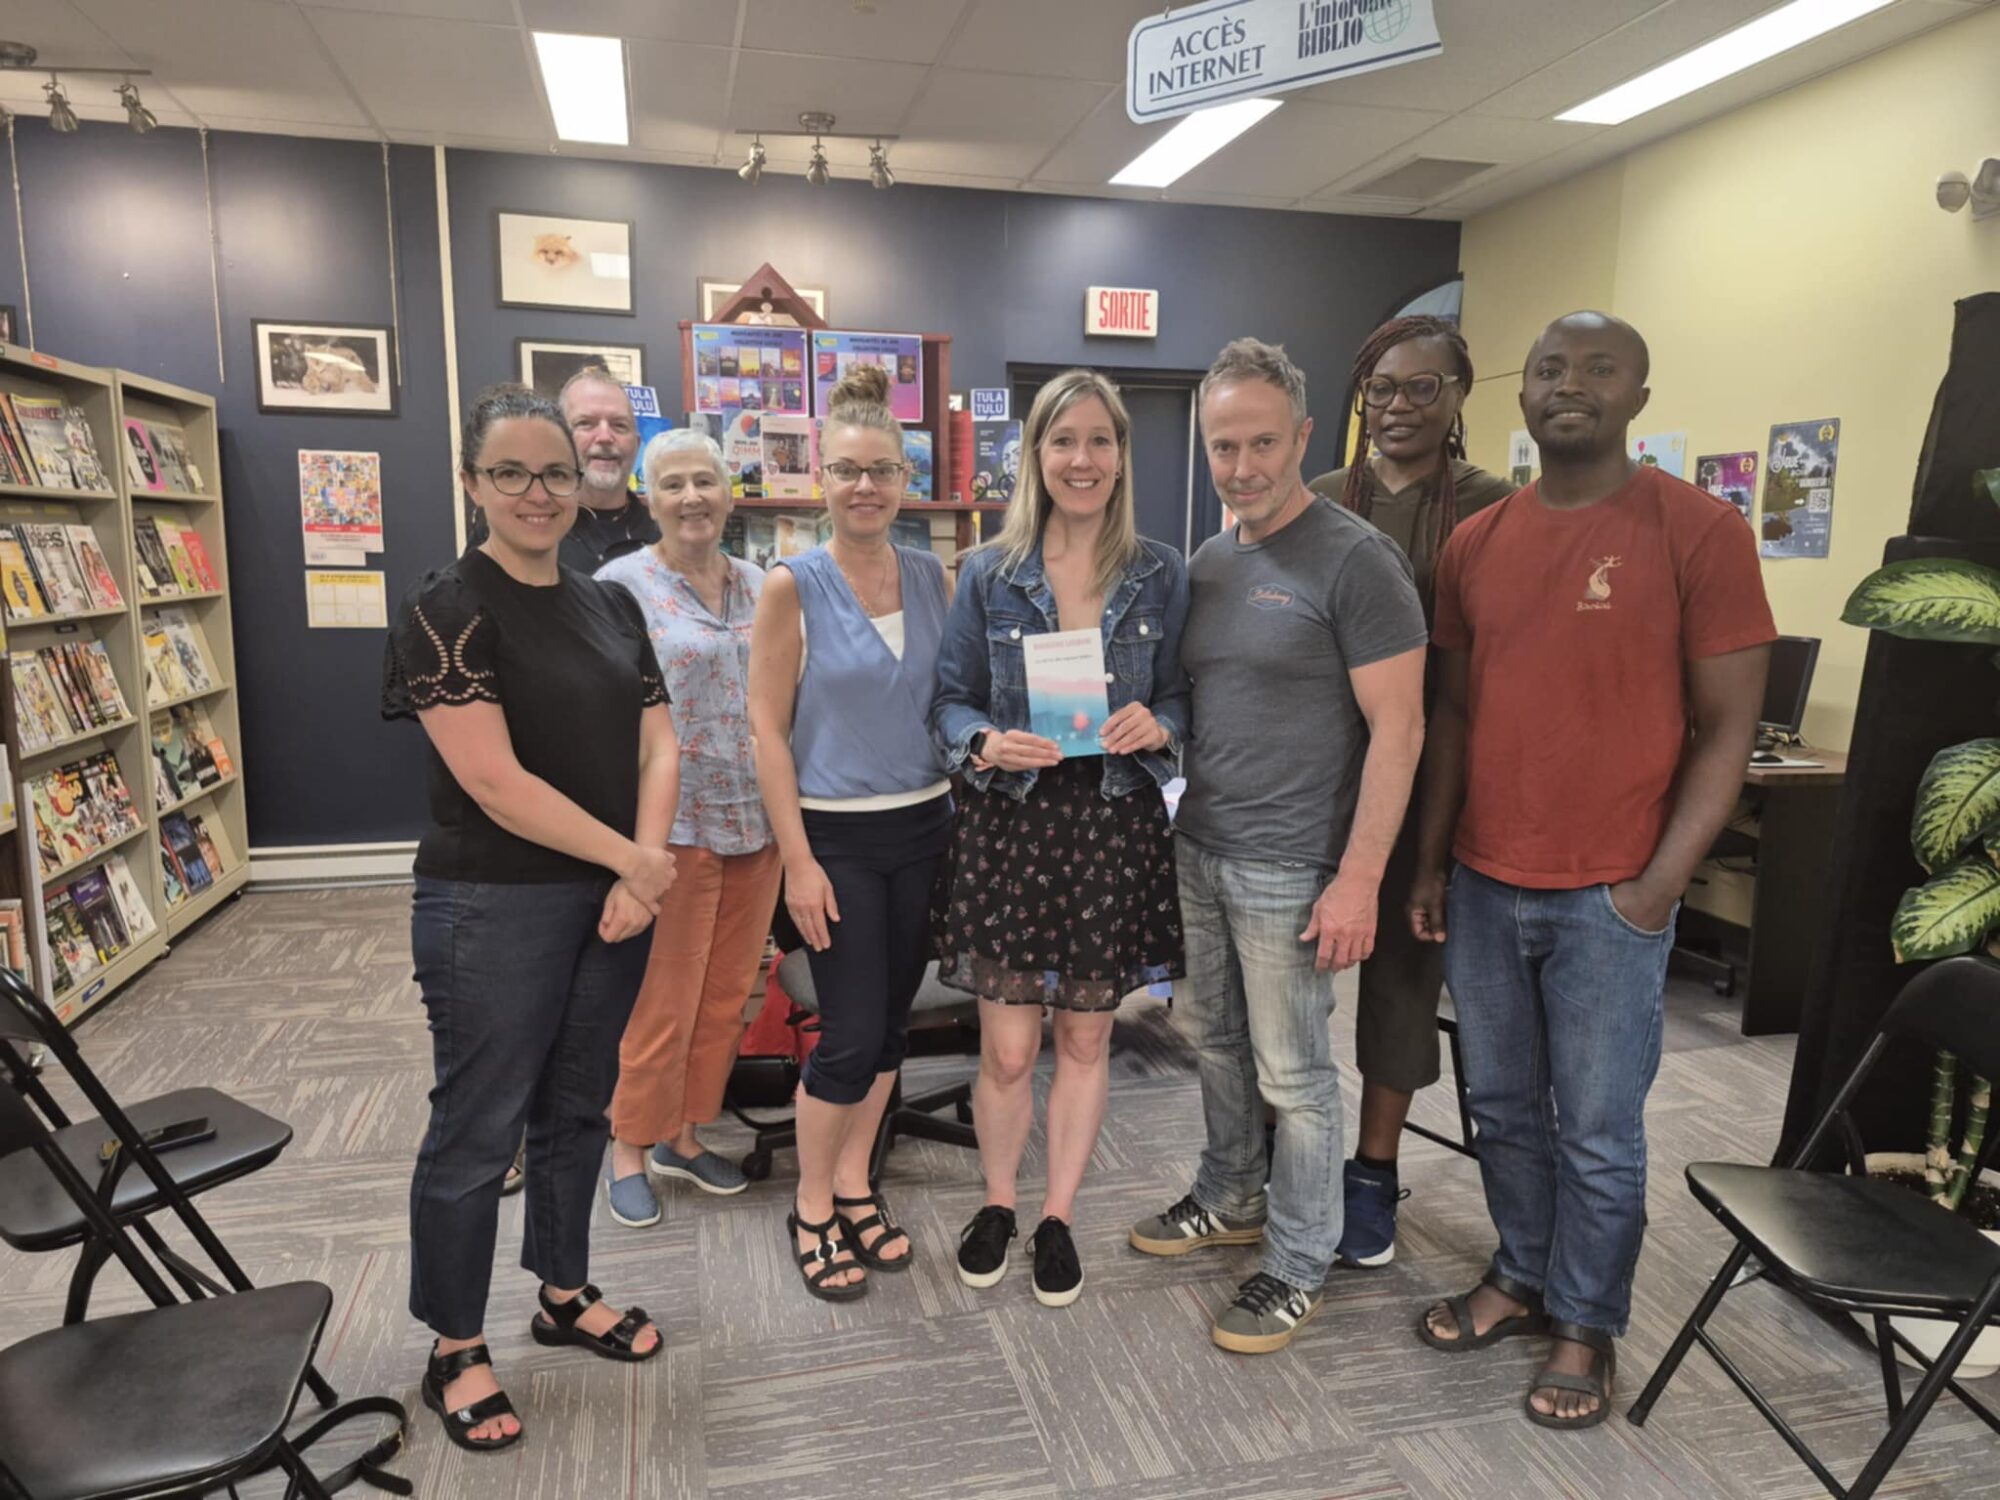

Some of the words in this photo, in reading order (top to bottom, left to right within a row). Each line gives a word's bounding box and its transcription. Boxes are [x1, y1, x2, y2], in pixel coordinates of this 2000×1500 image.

[1170, 16, 1246, 60] ACCÈS
[1298, 17, 1363, 59] BIBLIO
[1149, 45, 1265, 94] INTERNET
[1099, 290, 1151, 330] SORTIE
[631, 399, 654, 411] ULU
[976, 403, 1003, 415] TULU
[977, 391, 1003, 403] TULA
